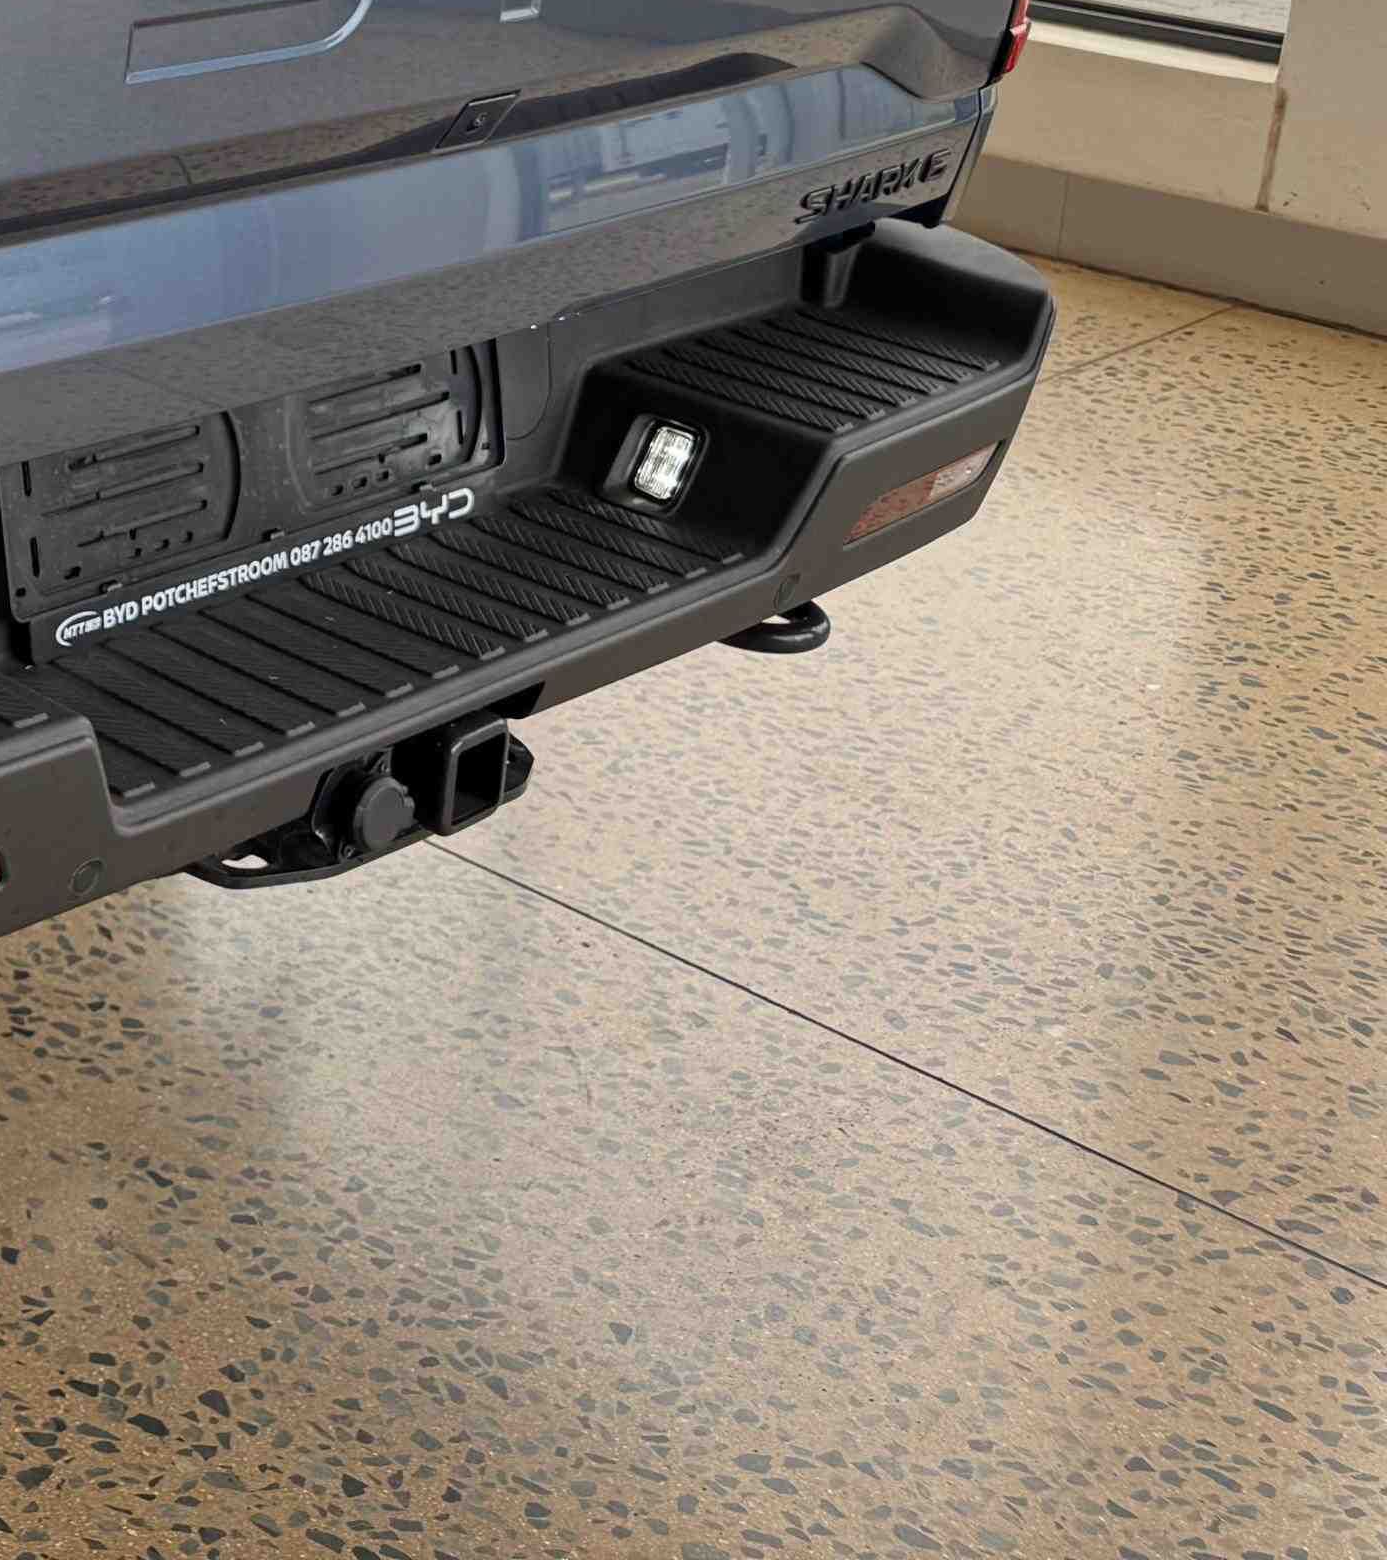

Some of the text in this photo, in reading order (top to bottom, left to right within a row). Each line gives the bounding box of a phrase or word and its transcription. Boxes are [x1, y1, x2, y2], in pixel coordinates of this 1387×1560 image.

[793, 157, 924, 225] SHARK
[103, 600, 139, 630] BYD
[141, 550, 288, 616] POTCHEFSTROOM
[290, 540, 322, 567] 087
[323, 529, 354, 557] 286
[354, 517, 393, 545] 4100
[393, 487, 475, 537] BYD
